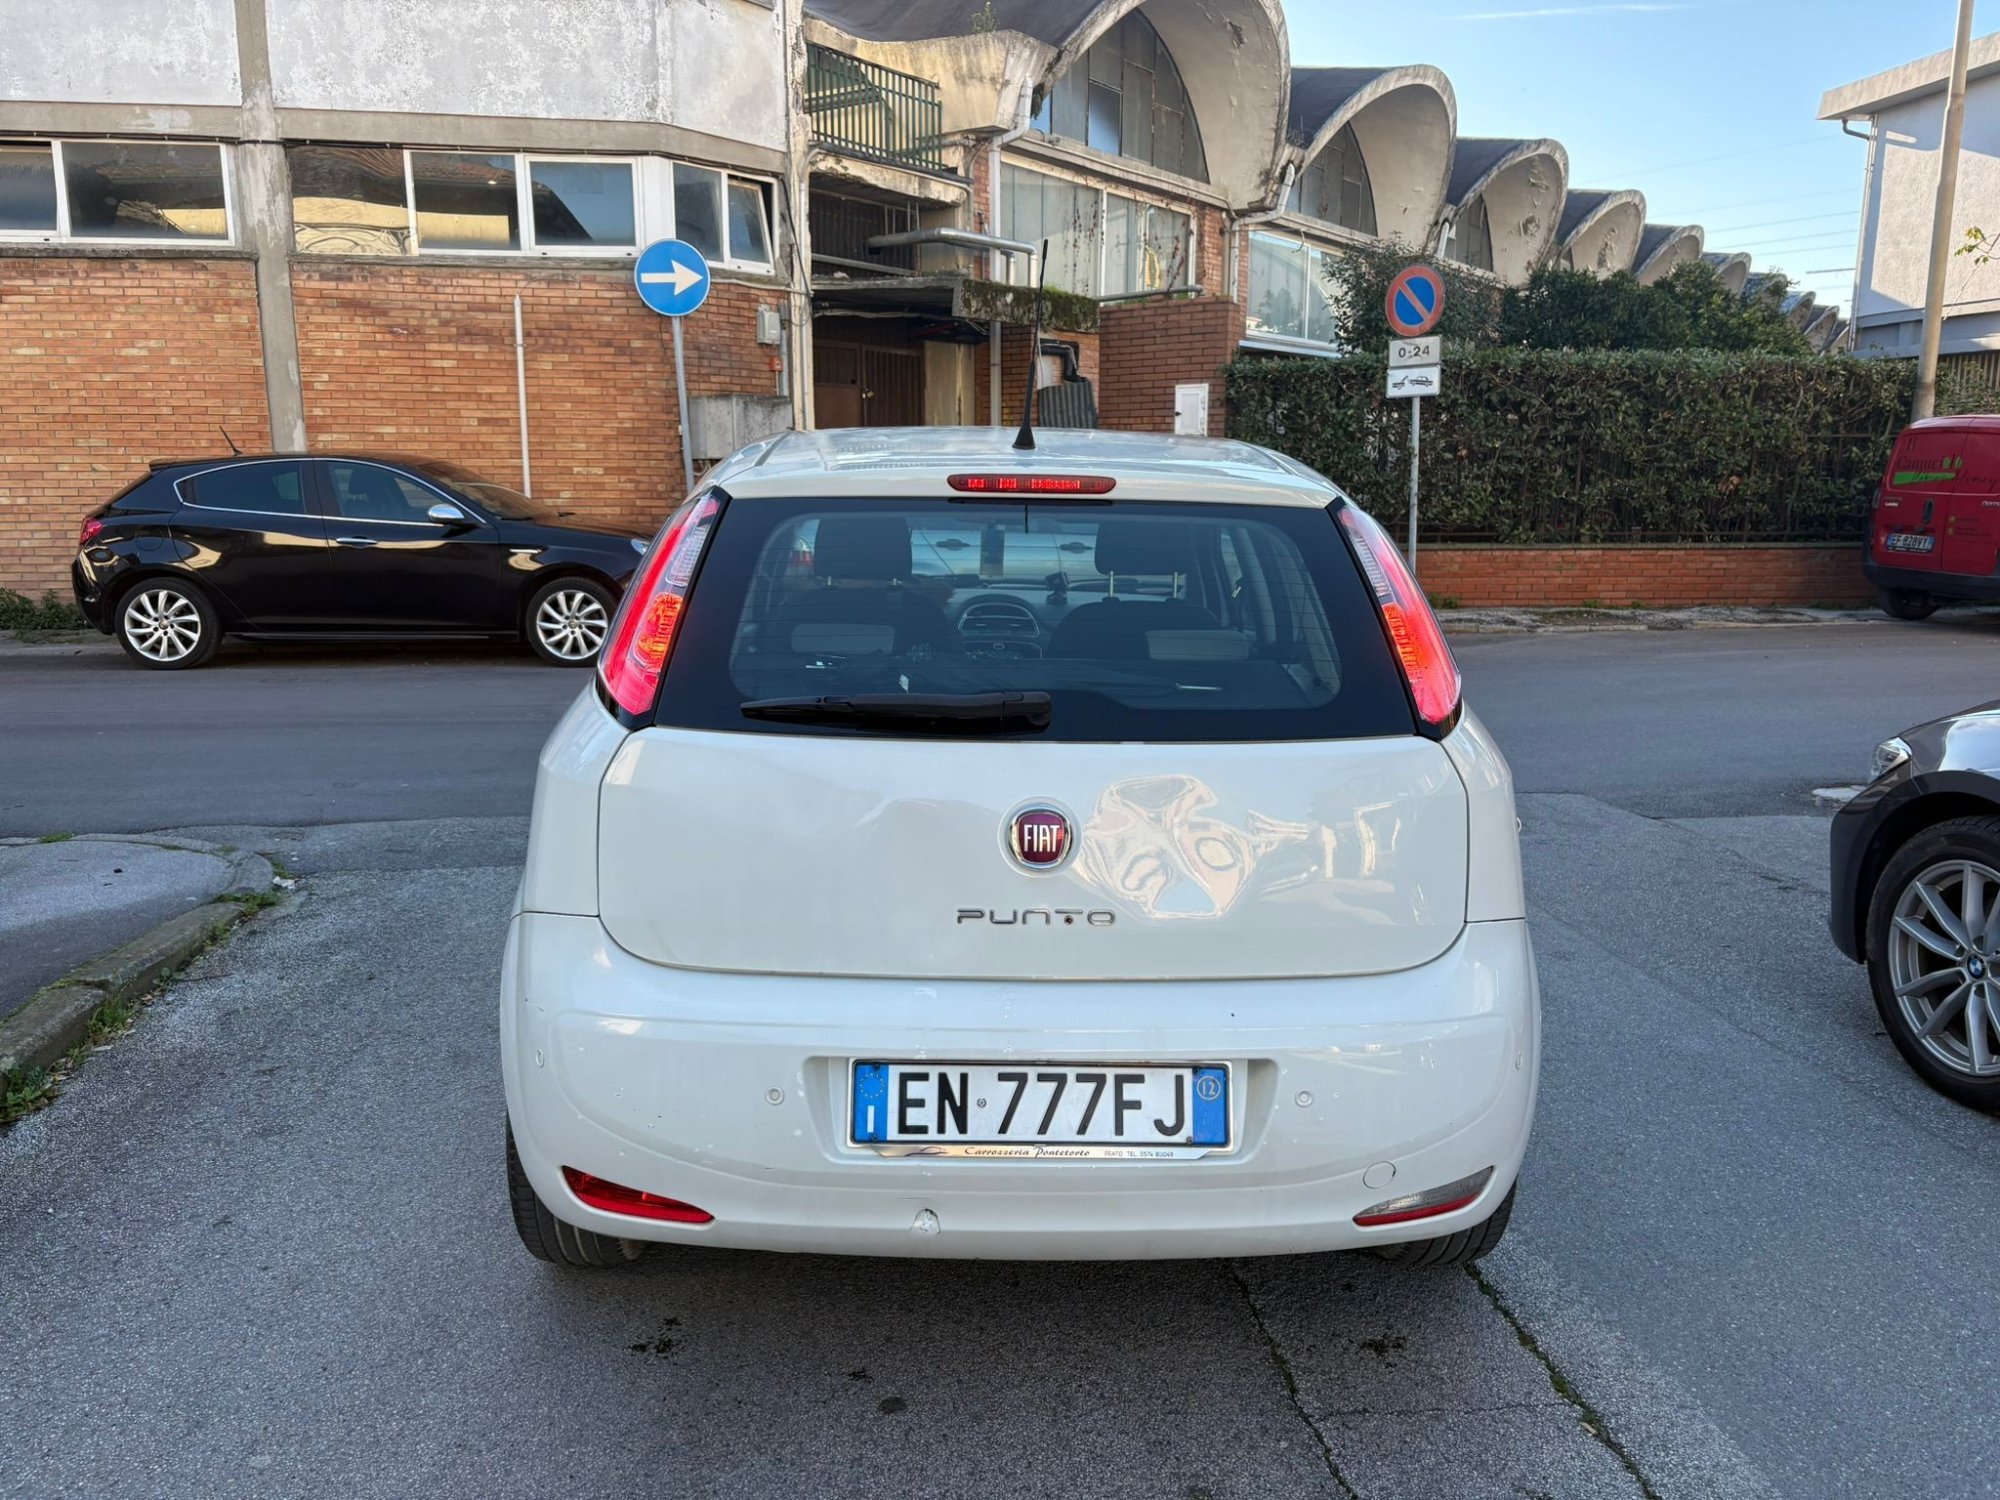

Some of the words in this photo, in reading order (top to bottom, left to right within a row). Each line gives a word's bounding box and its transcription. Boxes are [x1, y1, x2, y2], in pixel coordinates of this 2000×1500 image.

[1398, 345, 1430, 358] 0-24
[1023, 824, 1060, 852] FIAT
[956, 908, 1116, 926] PUNTO
[1202, 1081, 1216, 1096] 12
[964, 1146, 1030, 1157] Carrozzeria
[1034, 1146, 1091, 1158] Pontetorto
